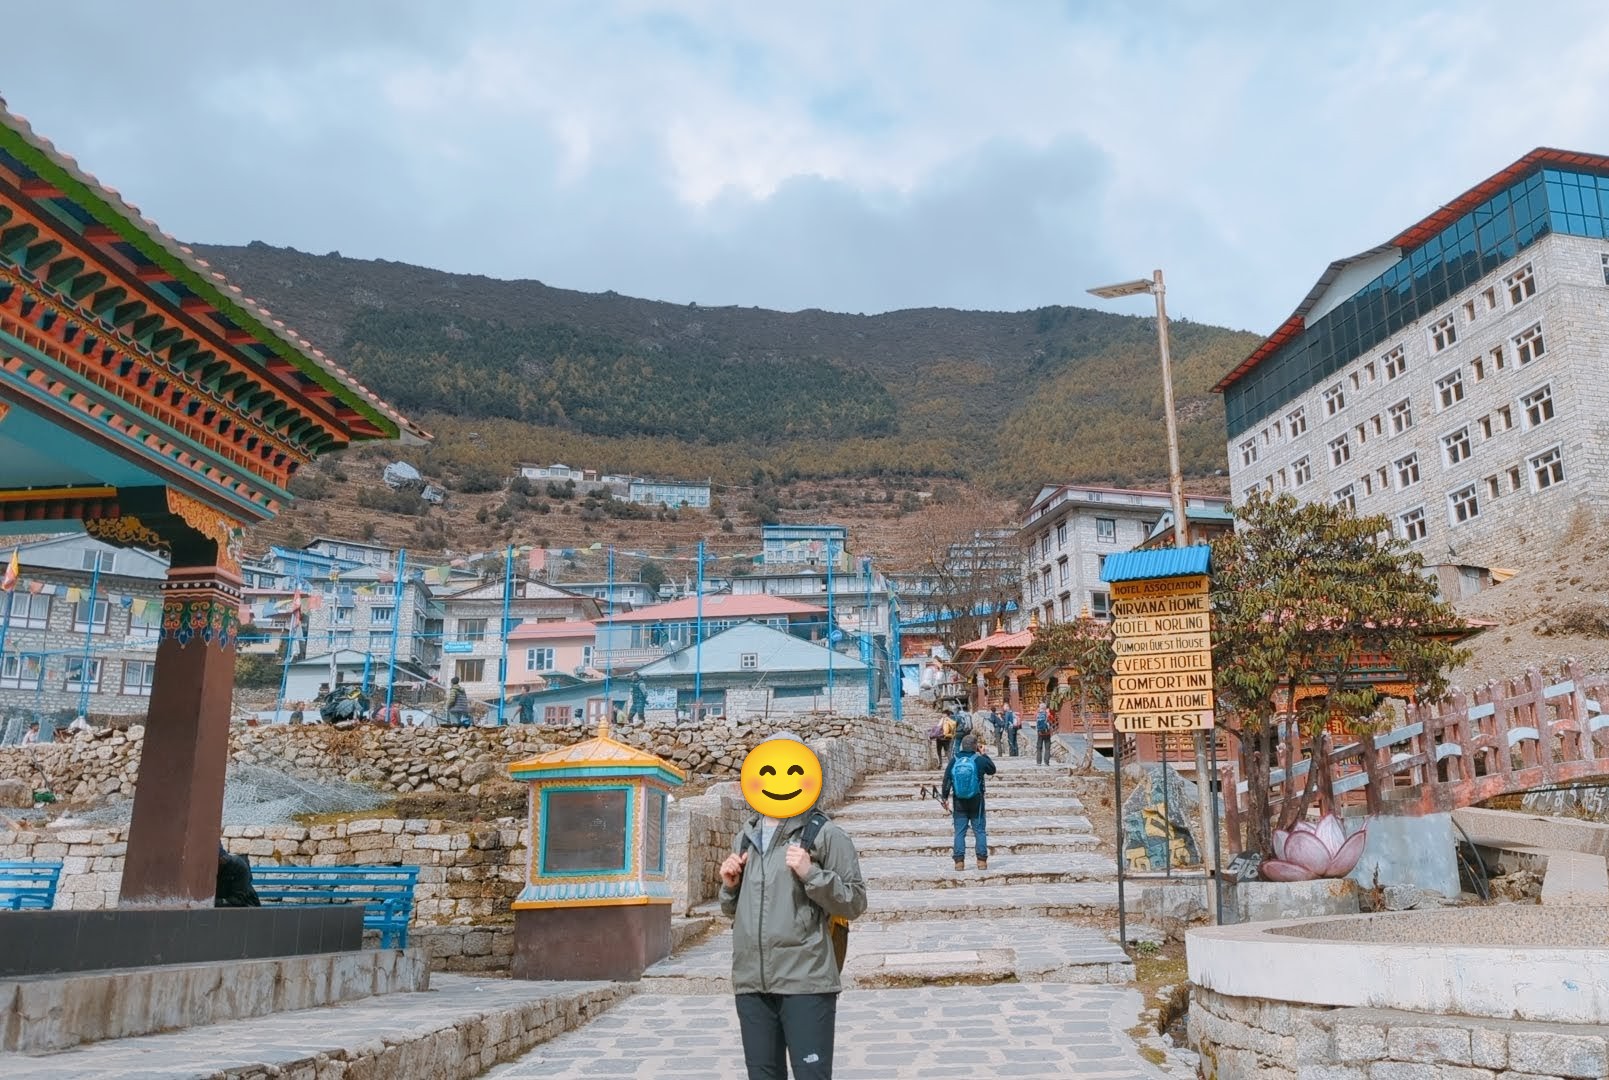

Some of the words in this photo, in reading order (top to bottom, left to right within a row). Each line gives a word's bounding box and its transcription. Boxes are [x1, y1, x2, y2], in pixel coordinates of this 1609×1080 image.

[1115, 585, 1141, 595] HOTEL
[1144, 580, 1202, 593] ASSOCIATION
[1115, 601, 1166, 616] NIRVANA
[1169, 597, 1204, 612] HOME
[1115, 620, 1151, 634] HOTEL
[1155, 617, 1203, 632] NORLING
[1116, 640, 1148, 653] PUMORI
[1149, 639, 1174, 651] GUEST
[1176, 636, 1204, 649] HOUSE
[1116, 657, 1167, 672] EVEREST
[1170, 655, 1206, 669] HOTEL
[1118, 675, 1183, 691] COMFORT
[1186, 674, 1207, 687] INN
[1118, 696, 1173, 711] ZAMBALA
[1176, 693, 1207, 708] HOME
[1121, 716, 1153, 730] THE
[1157, 713, 1203, 729] NEST
